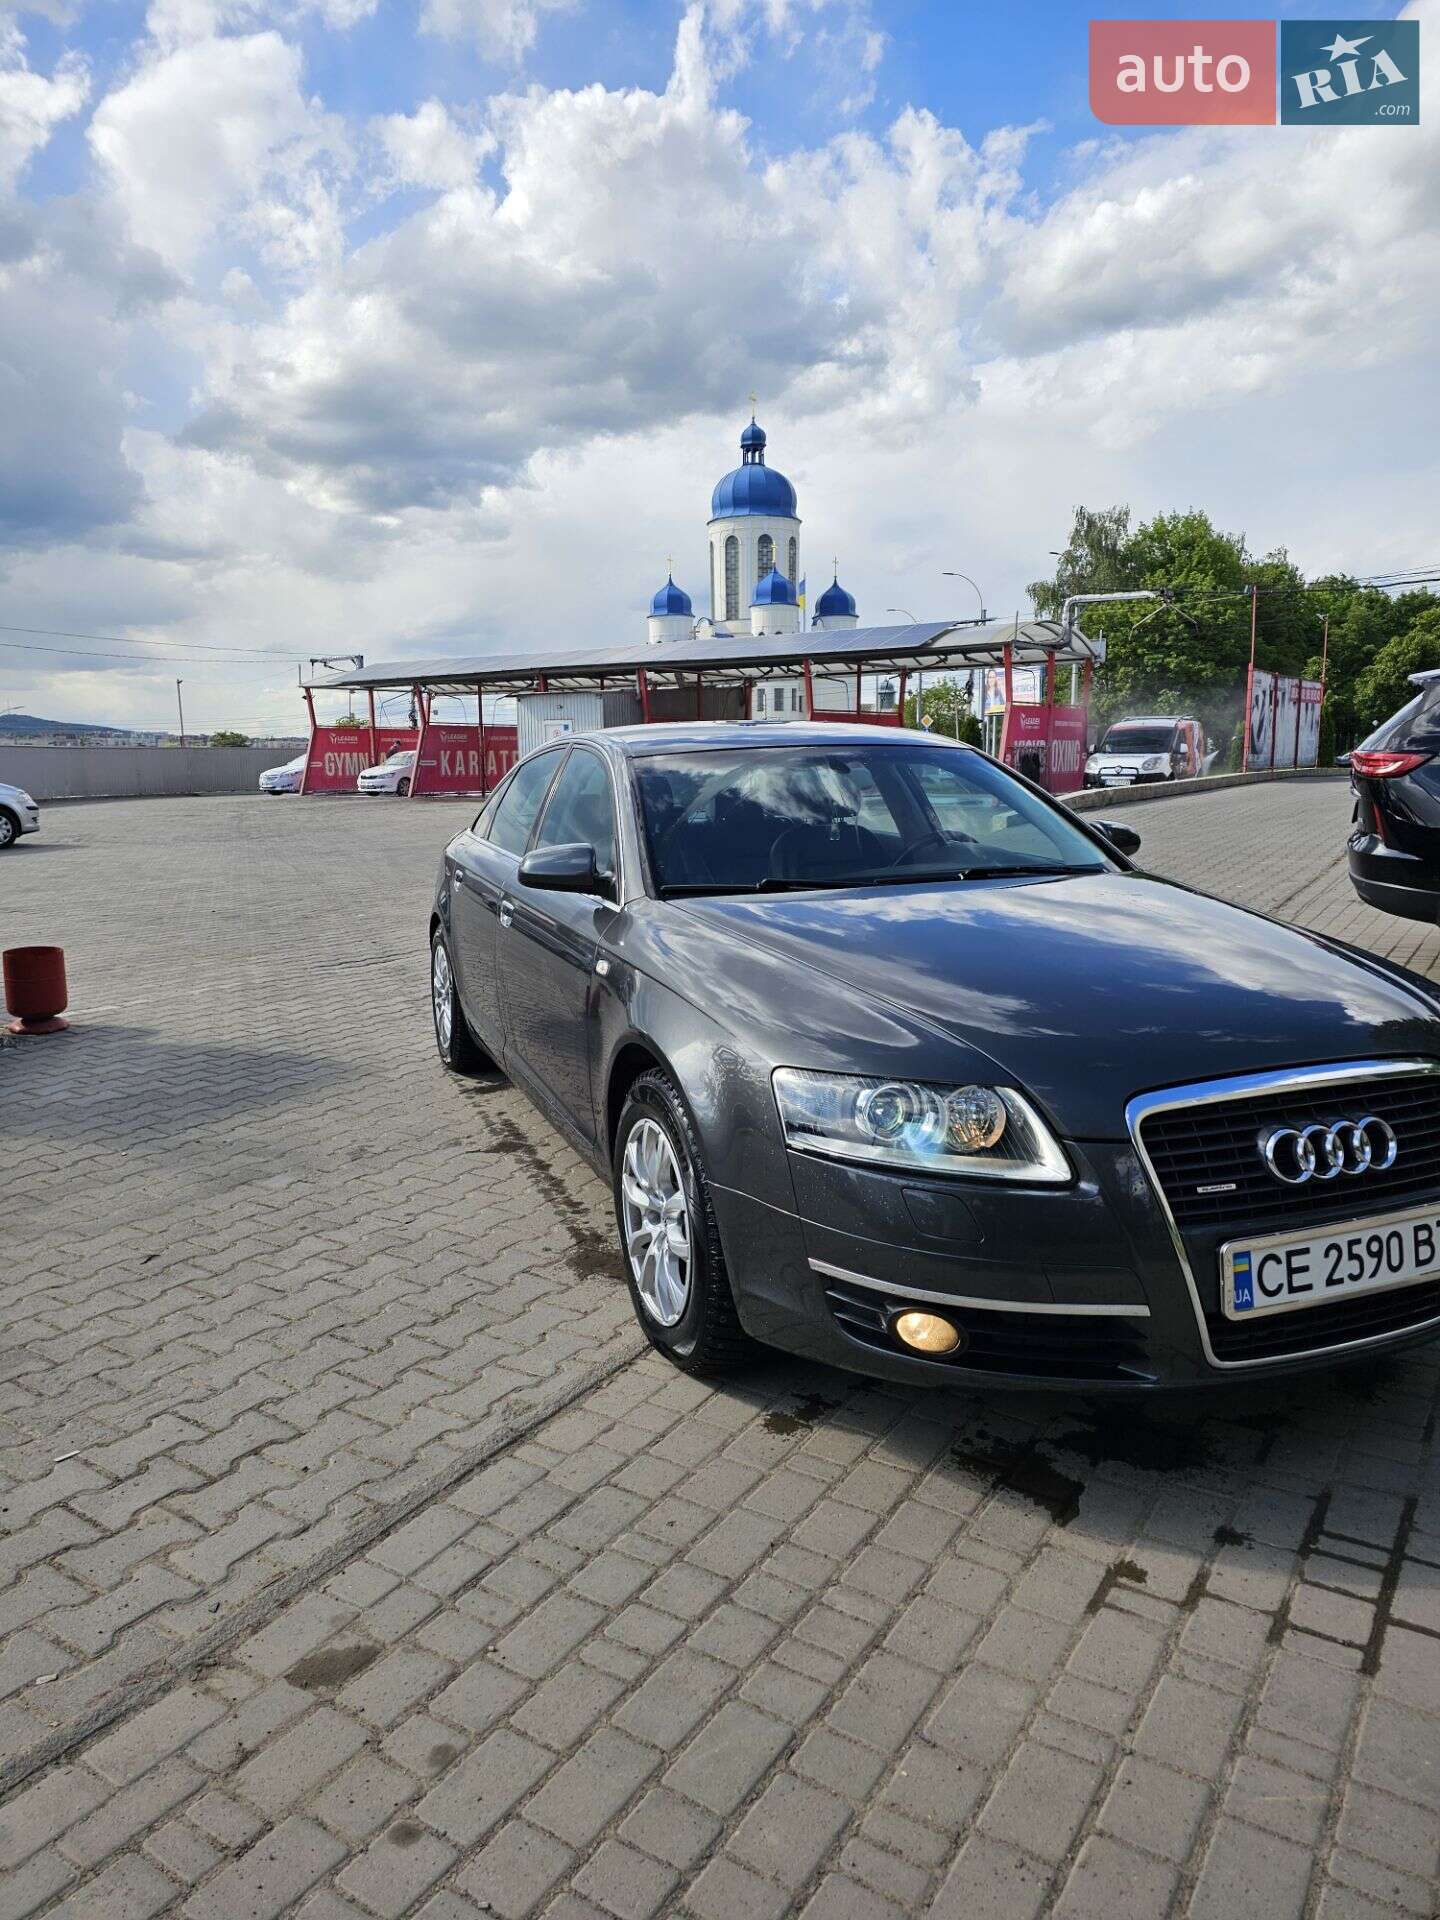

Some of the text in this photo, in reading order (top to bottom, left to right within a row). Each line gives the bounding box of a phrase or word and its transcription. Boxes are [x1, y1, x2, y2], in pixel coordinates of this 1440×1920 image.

[1257, 1218, 1440, 1298] CE 2590 B
[1234, 1288, 1252, 1305] UA
